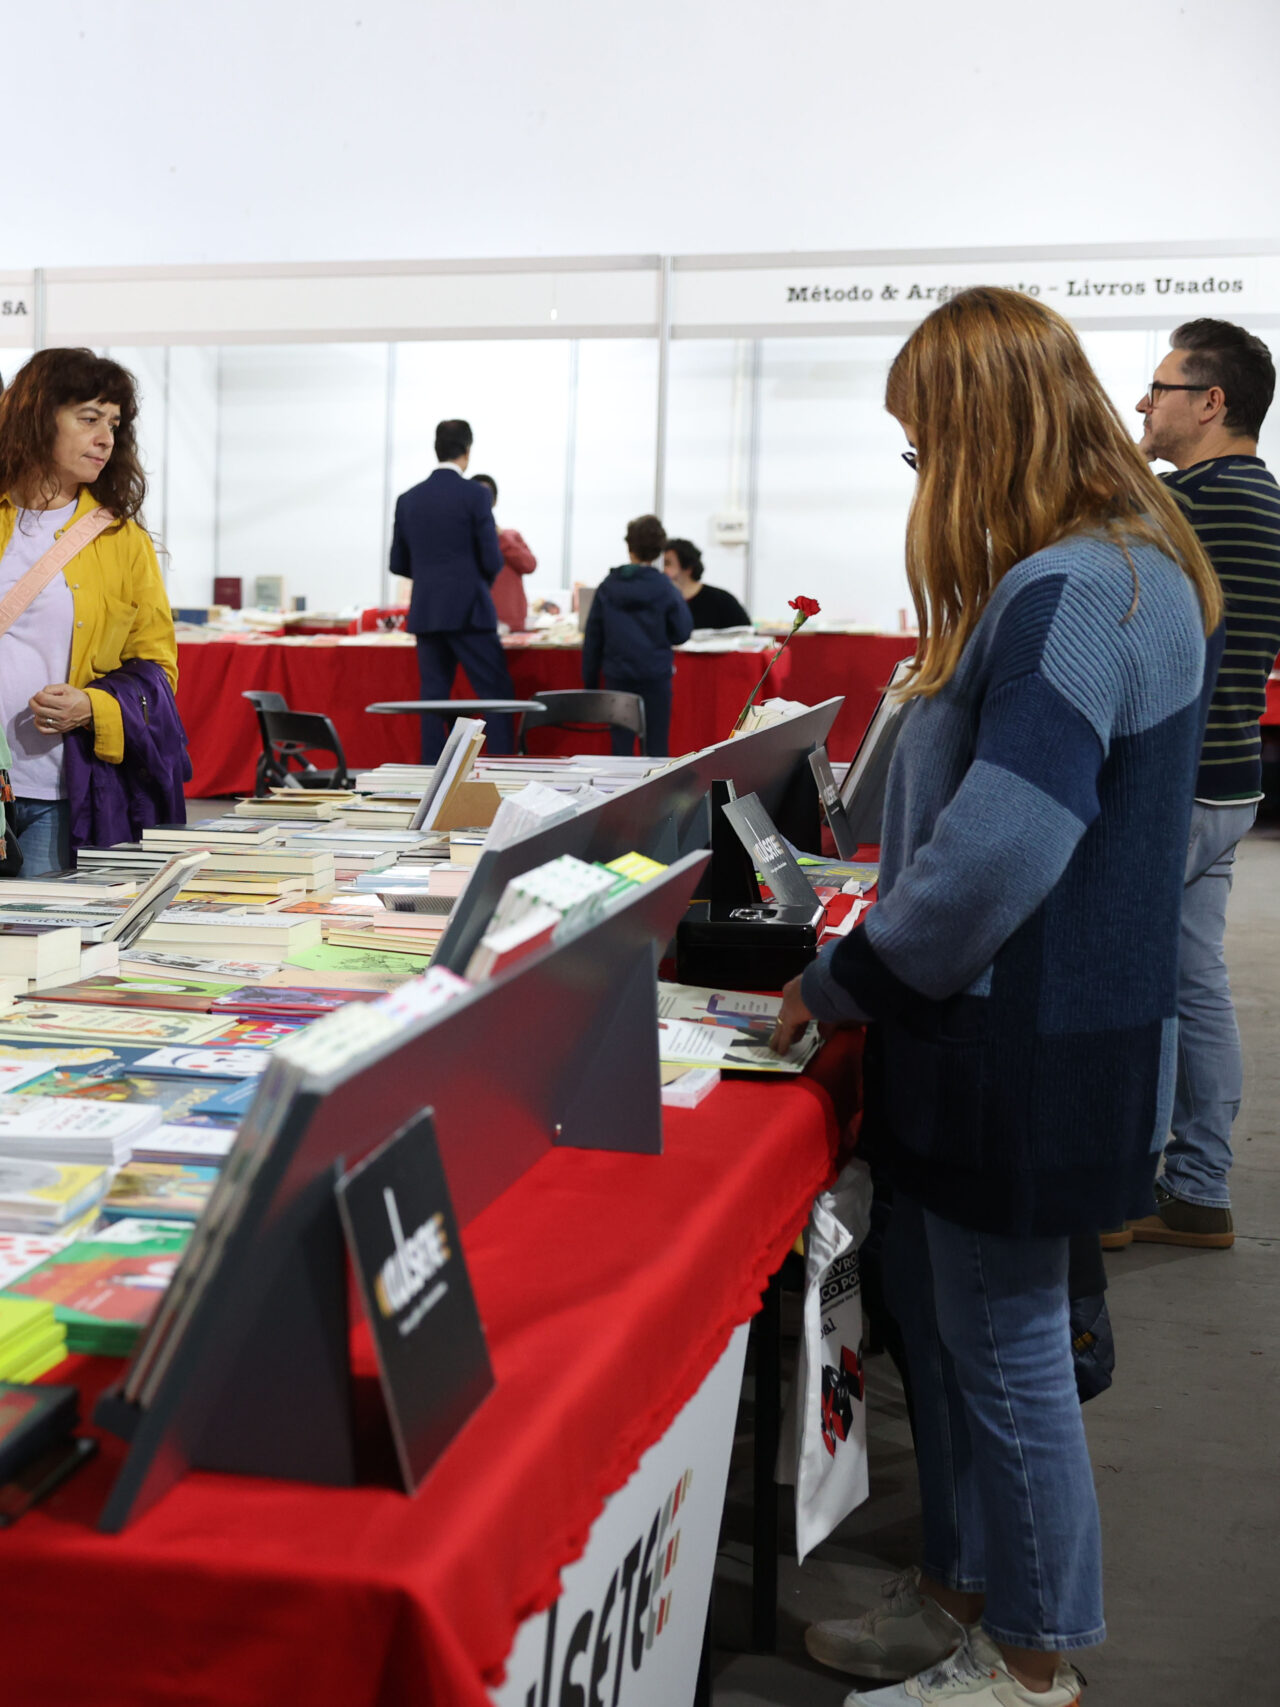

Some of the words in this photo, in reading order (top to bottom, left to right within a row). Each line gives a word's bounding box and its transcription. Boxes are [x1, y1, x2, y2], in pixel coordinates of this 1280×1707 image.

[787, 284, 874, 303] Método
[880, 284, 900, 301] &
[1066, 279, 1147, 298] Livros
[1155, 276, 1244, 296] Usados
[1, 300, 28, 317] SA
